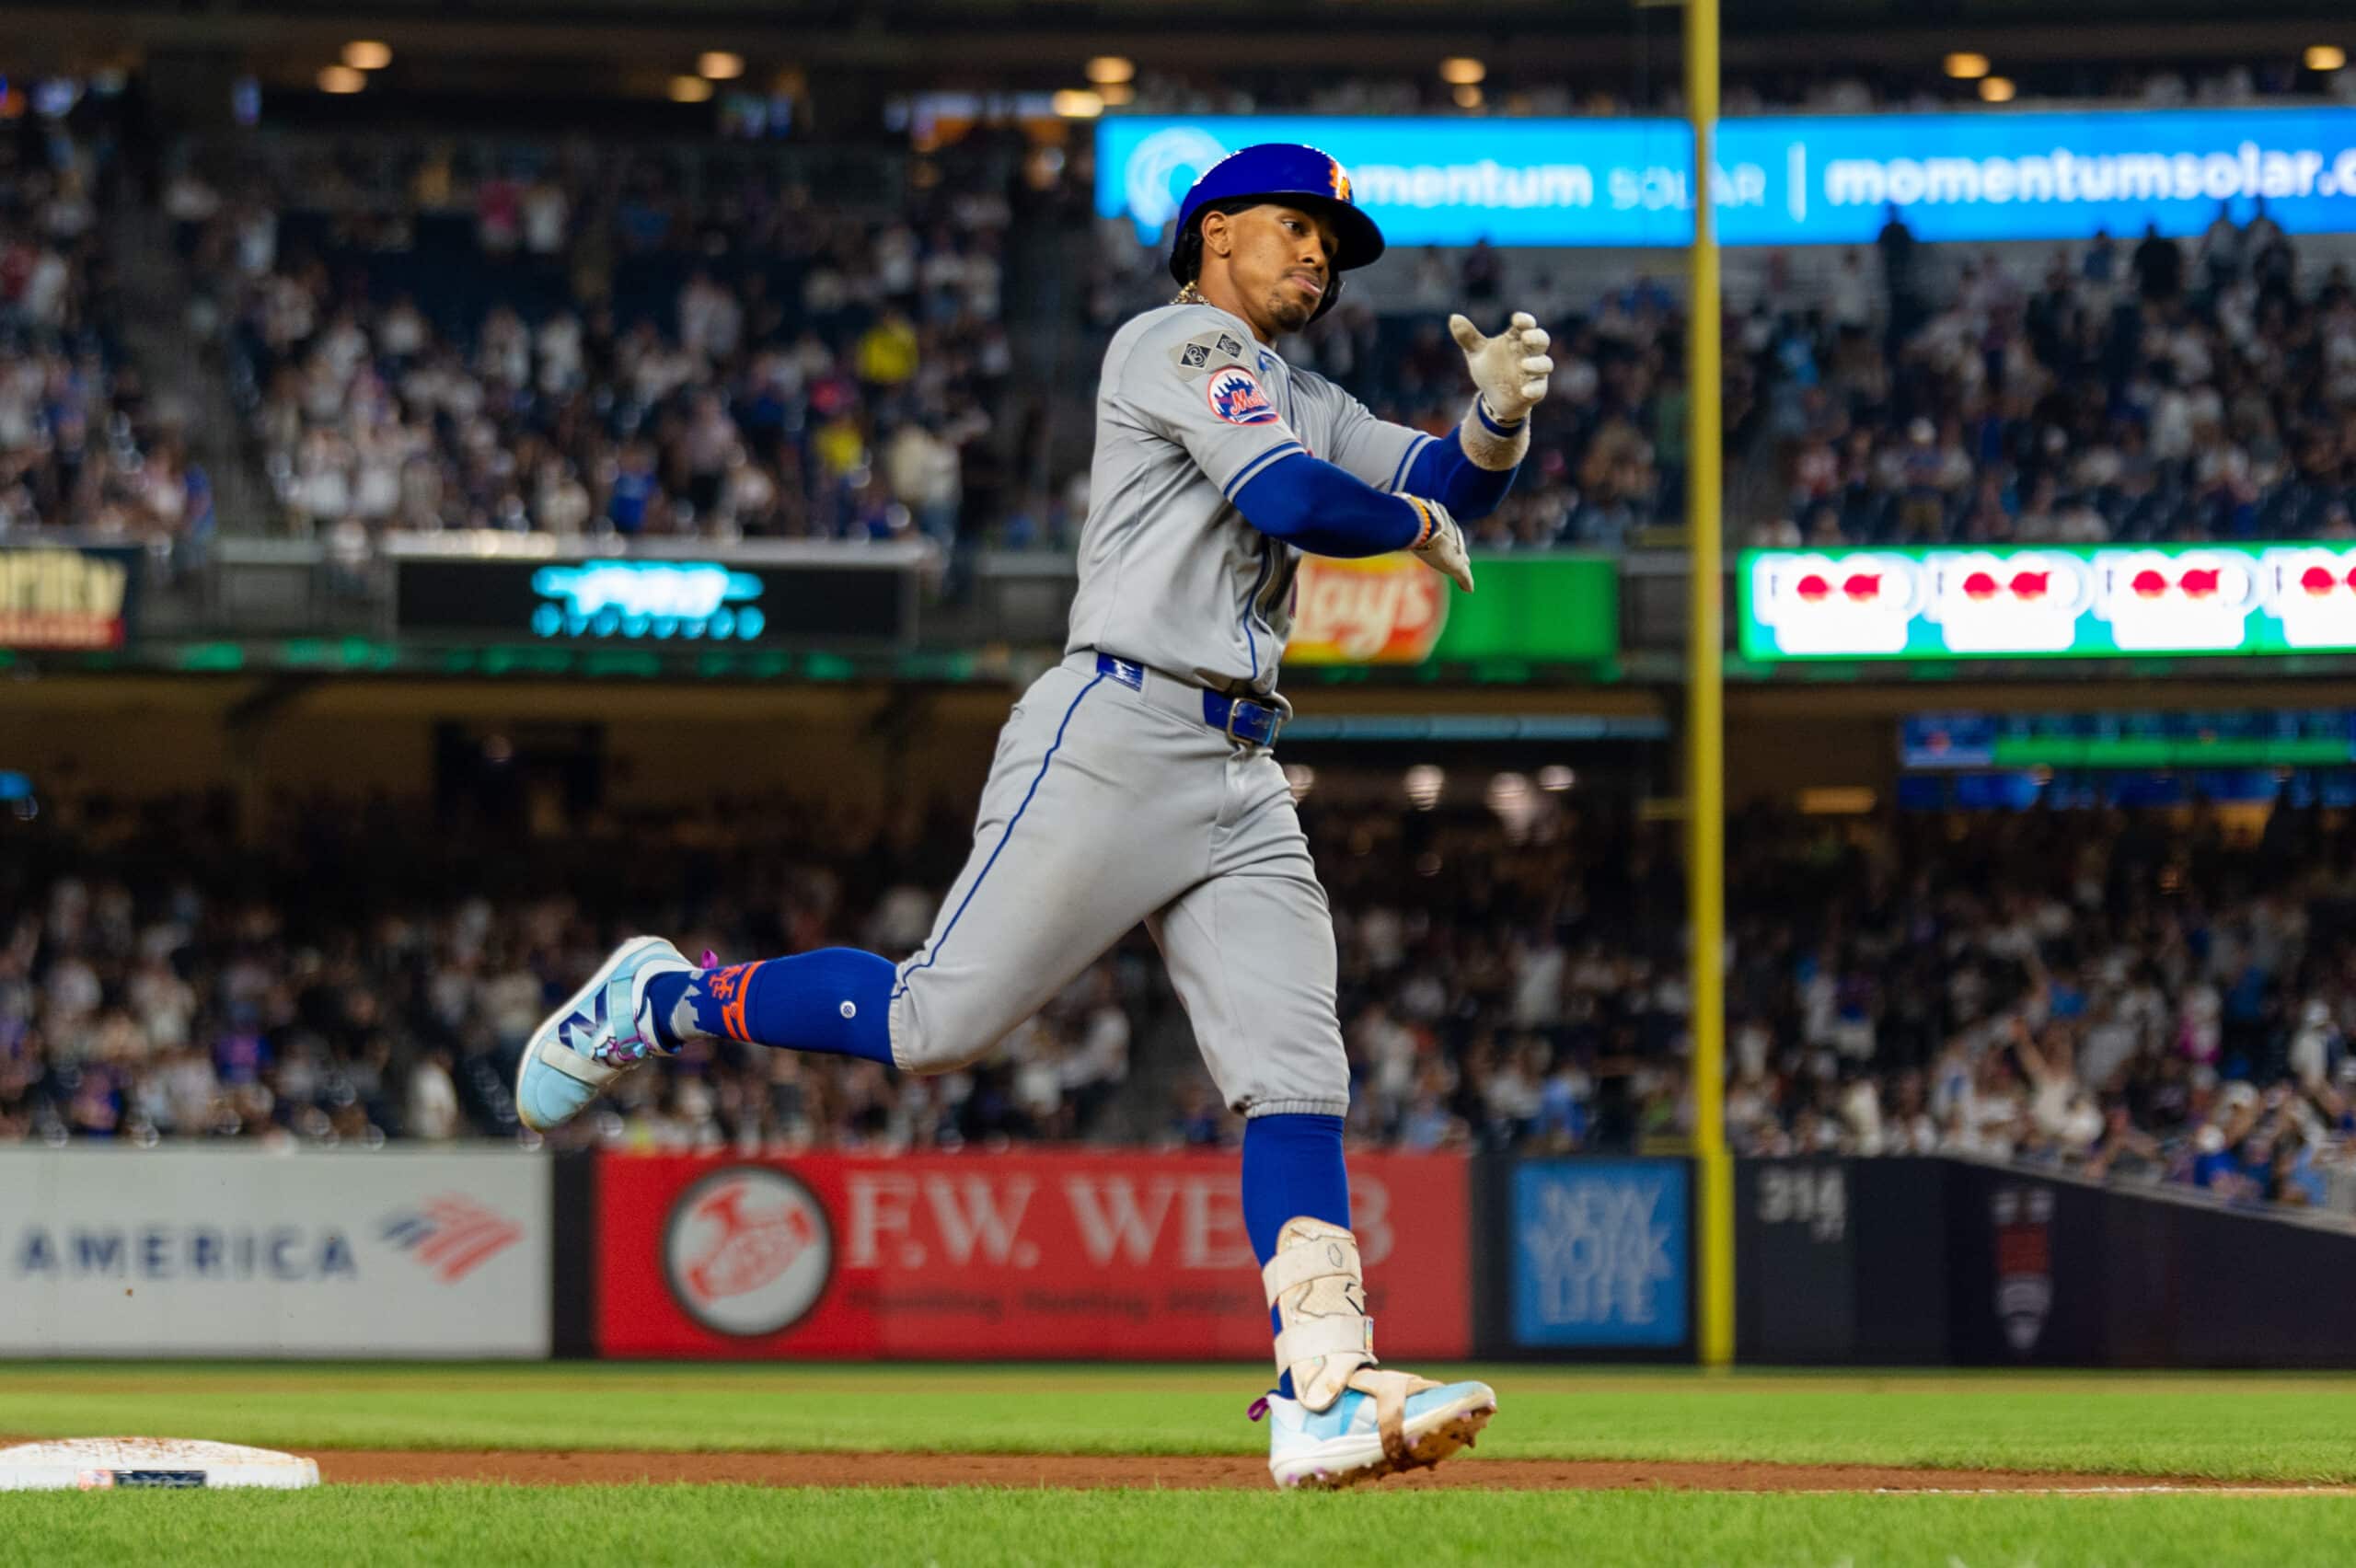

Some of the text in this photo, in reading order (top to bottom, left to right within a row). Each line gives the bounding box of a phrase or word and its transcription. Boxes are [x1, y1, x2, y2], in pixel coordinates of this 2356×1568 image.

[1348, 159, 1593, 208] mentum
[1065, 1174, 1394, 1269] WEB
[1542, 1182, 1662, 1225] NEW
[1761, 1169, 1844, 1222] 314
[17, 1227, 357, 1281] AMERICA
[1525, 1224, 1673, 1277] YORK
[1542, 1275, 1657, 1326] LIFE
